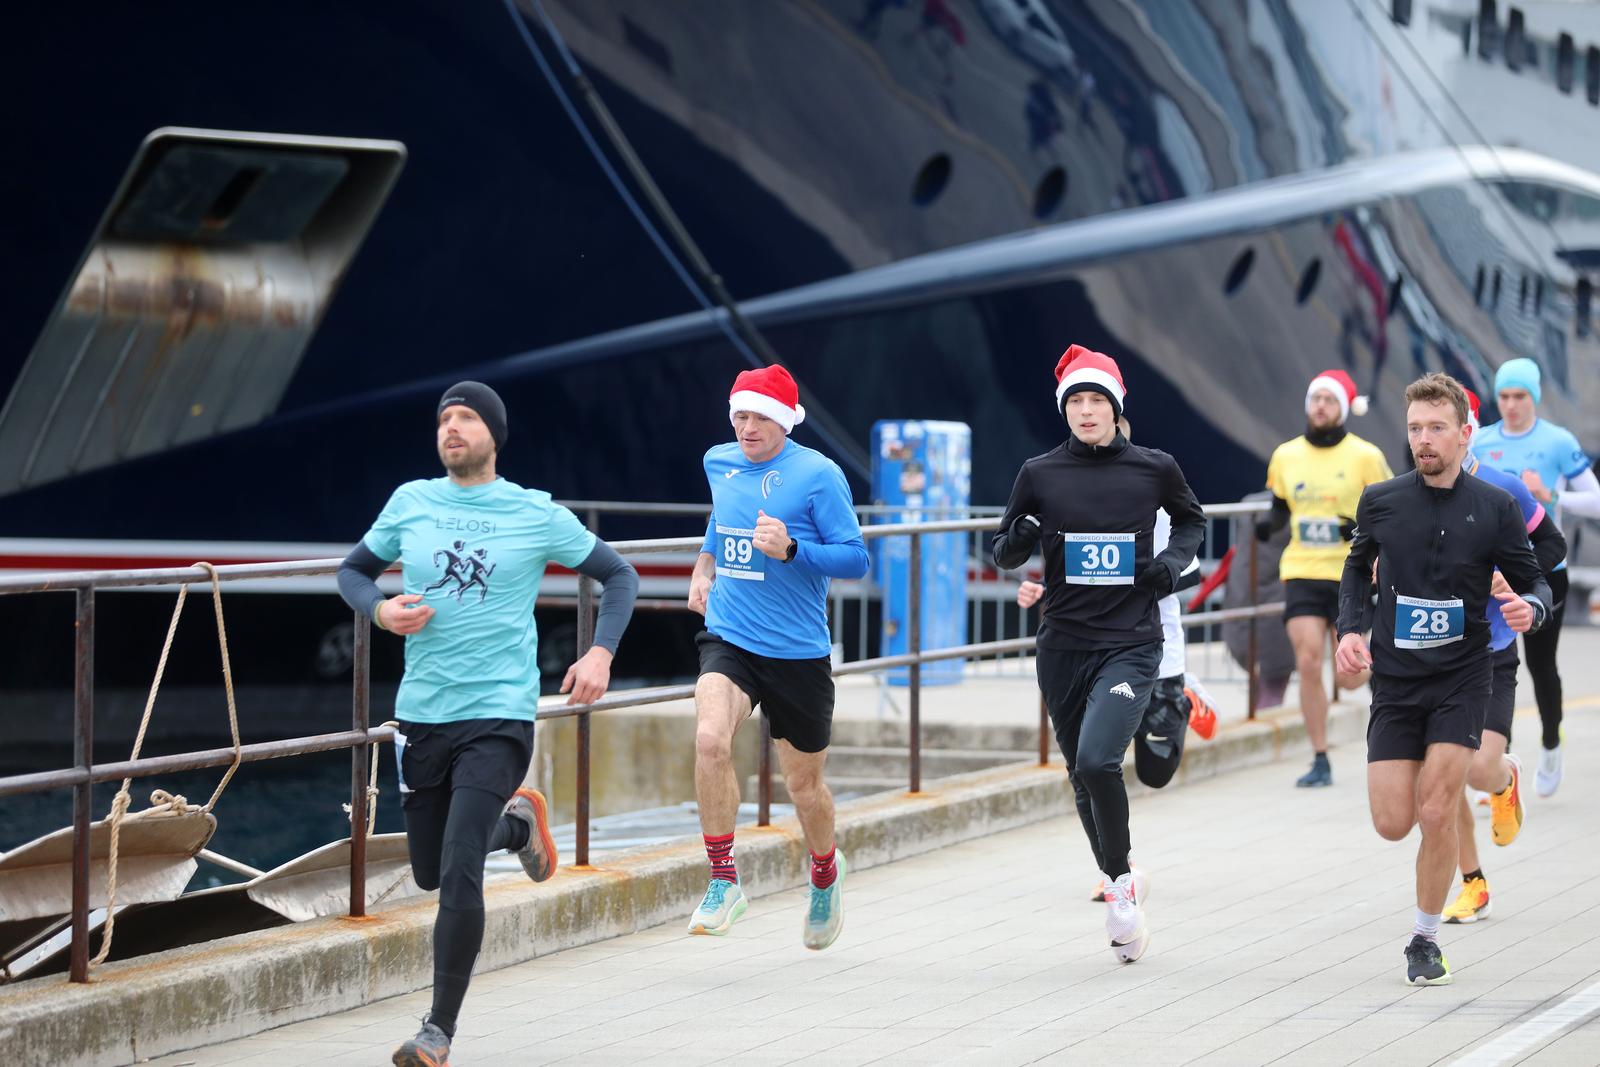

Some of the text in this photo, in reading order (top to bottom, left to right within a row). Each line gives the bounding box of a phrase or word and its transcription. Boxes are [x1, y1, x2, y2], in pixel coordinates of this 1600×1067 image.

[1306, 521, 1330, 538] 44
[724, 538, 752, 564] 89
[1081, 544, 1120, 570] 30
[1404, 598, 1429, 606] TORPEDO
[1410, 608, 1450, 634] 28
